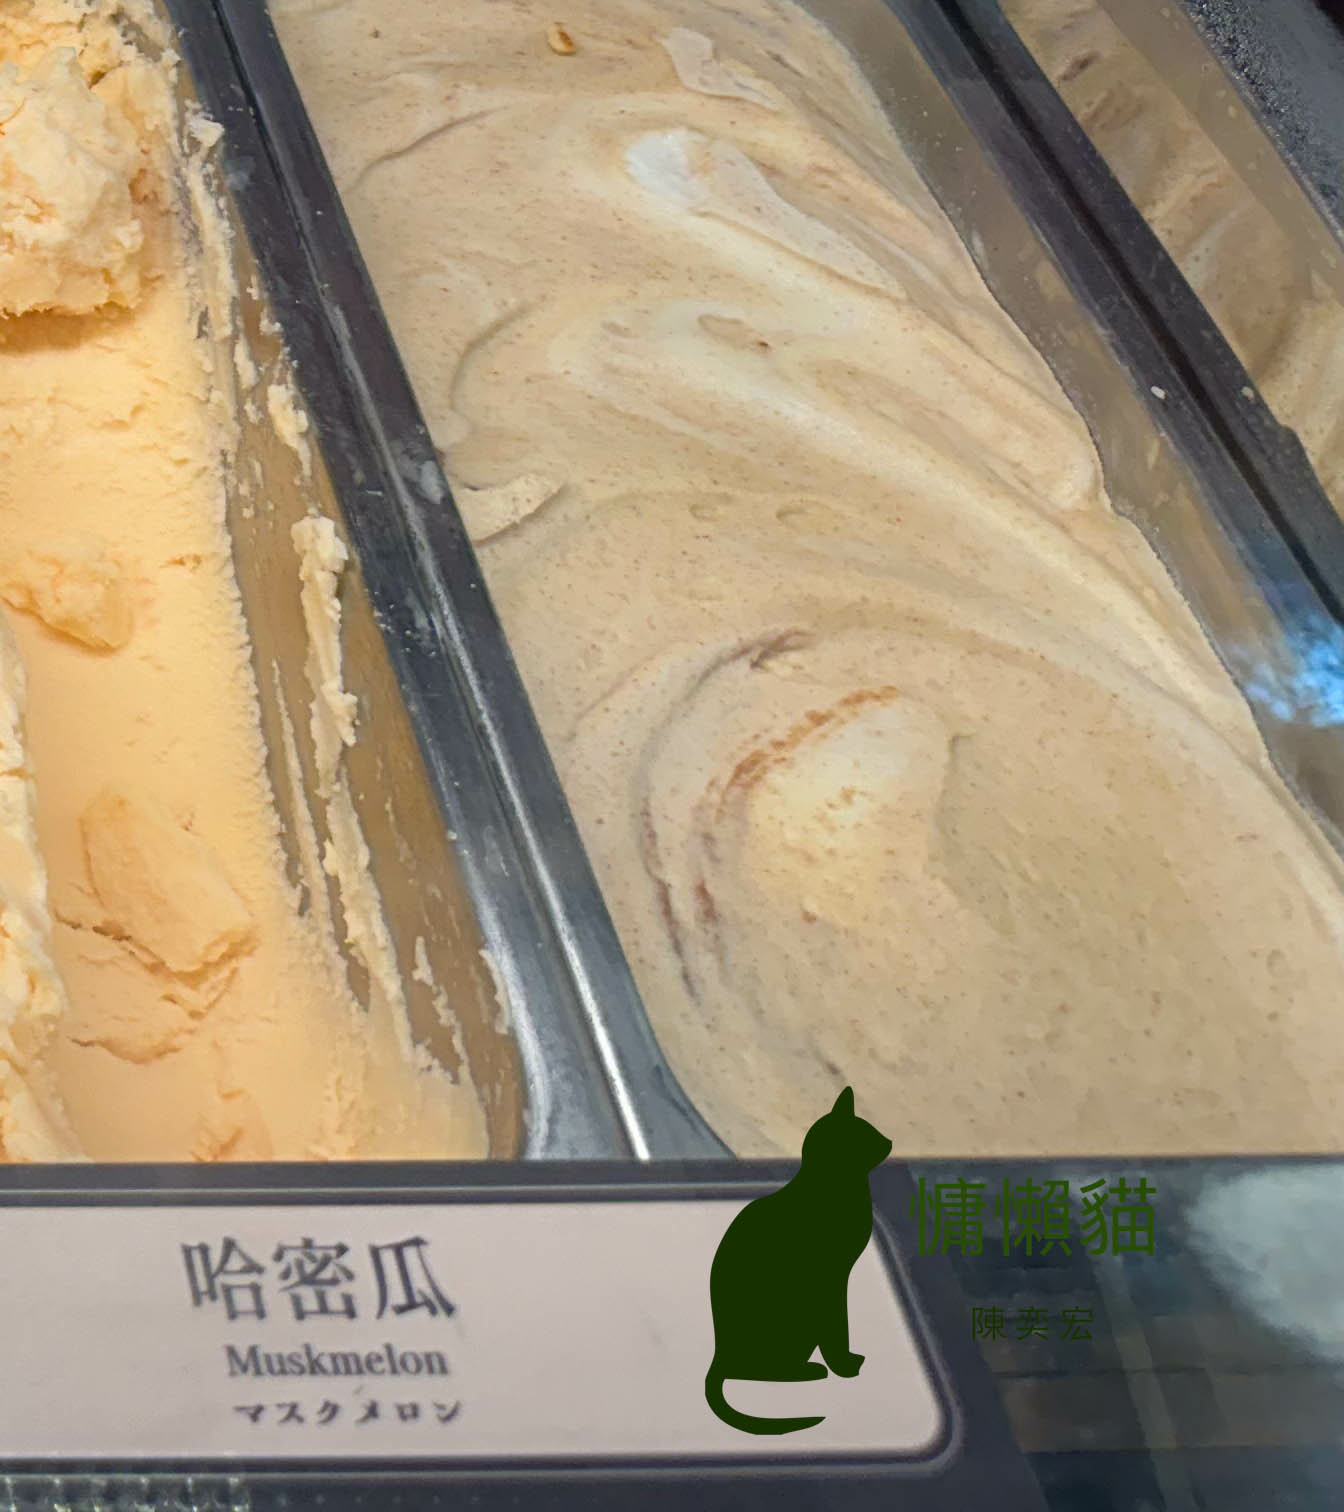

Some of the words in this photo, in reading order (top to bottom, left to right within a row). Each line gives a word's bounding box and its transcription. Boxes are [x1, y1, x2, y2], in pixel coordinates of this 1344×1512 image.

[180, 1236, 455, 1322] 哈密瓜
[223, 1343, 449, 1379] Muskmelon
[232, 1400, 463, 1426] マスクメロン
